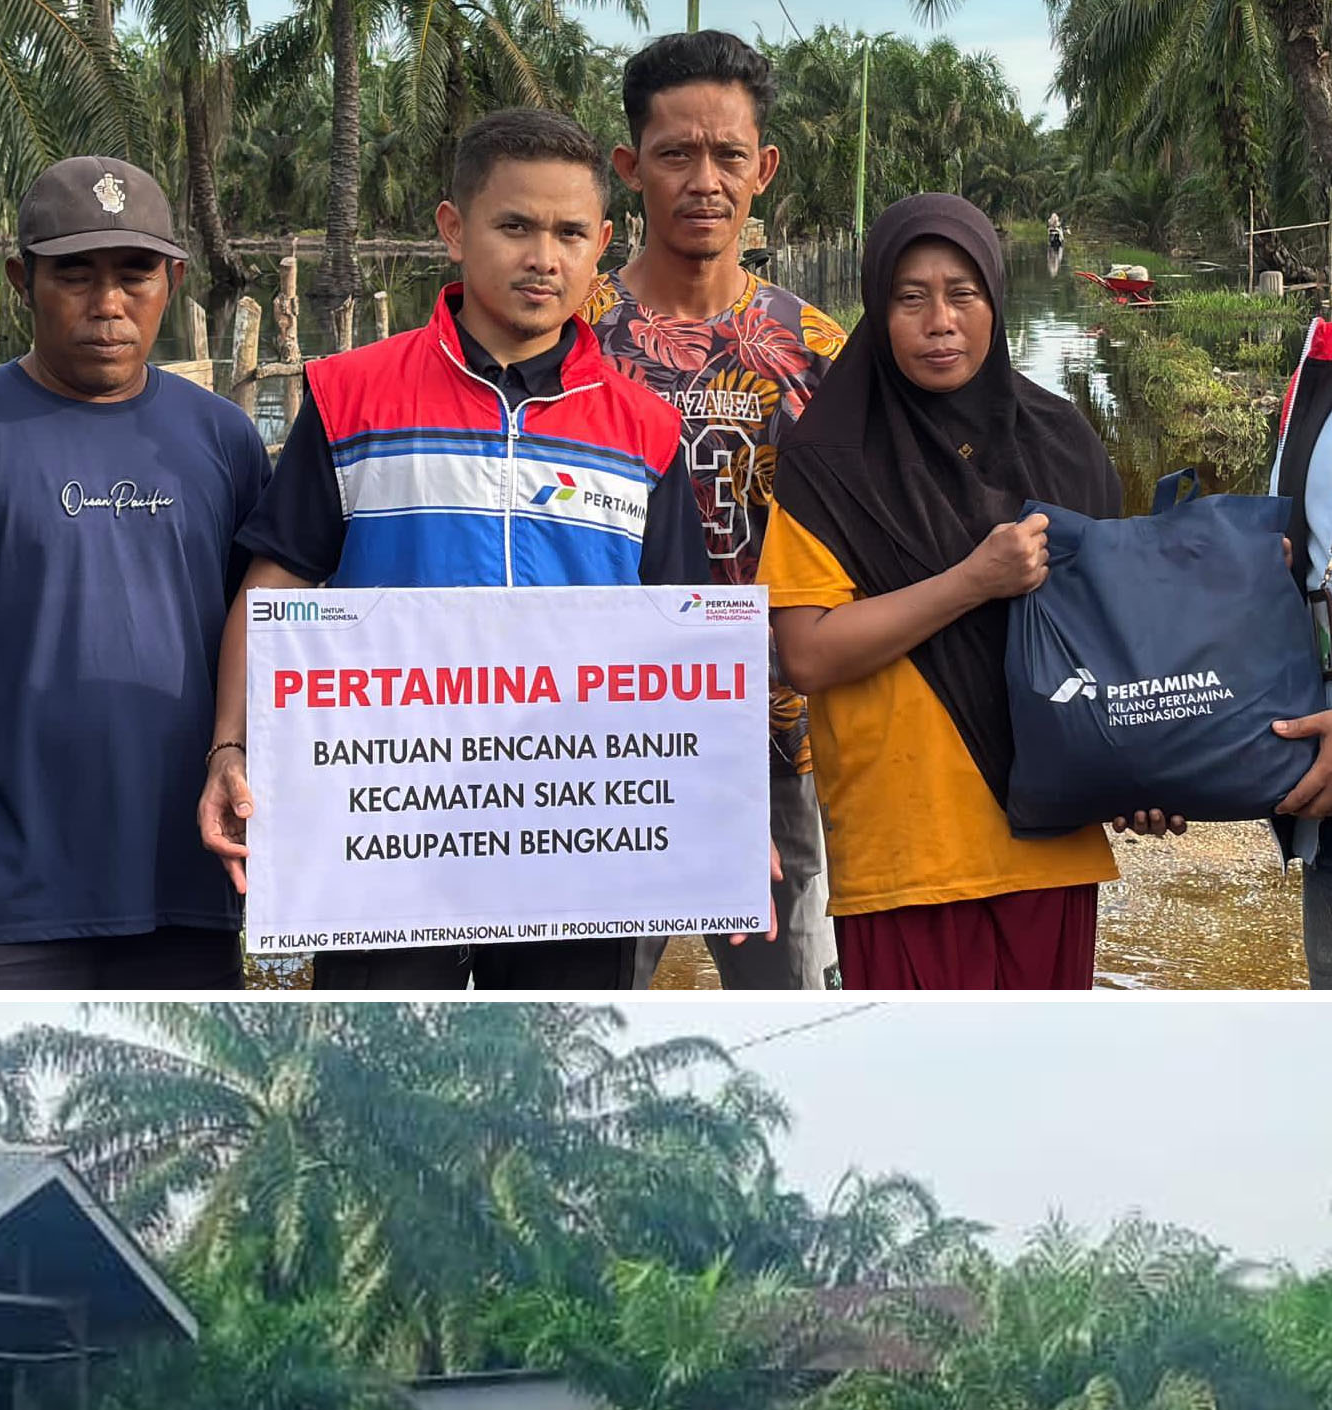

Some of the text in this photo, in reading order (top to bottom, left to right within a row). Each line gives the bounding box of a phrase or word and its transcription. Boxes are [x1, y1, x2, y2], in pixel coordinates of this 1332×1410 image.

[61, 480, 174, 517] Ocean Pacific
[680, 424, 756, 560] 3
[253, 601, 319, 621] BUMN
[705, 600, 755, 609] PERTAMINA
[705, 608, 728, 616] KILANG
[274, 663, 745, 708] PERTAMINA PEDULI
[1107, 670, 1222, 699] PERTAMINA
[1108, 688, 1234, 714] KILANG PERTAMINA
[1108, 703, 1214, 727] INTERNASIONAL
[314, 732, 700, 766] BANTUAN BENCANA BANJIR
[349, 779, 675, 813] KECAMATAN SIAK KECIL
[345, 826, 669, 861] KABUPATEN BENGKALIS
[260, 915, 761, 949] PT KILANG PERTAMINA INTERNASIONAL UNIT II PRODUCTION SUNGAI PAKNING
